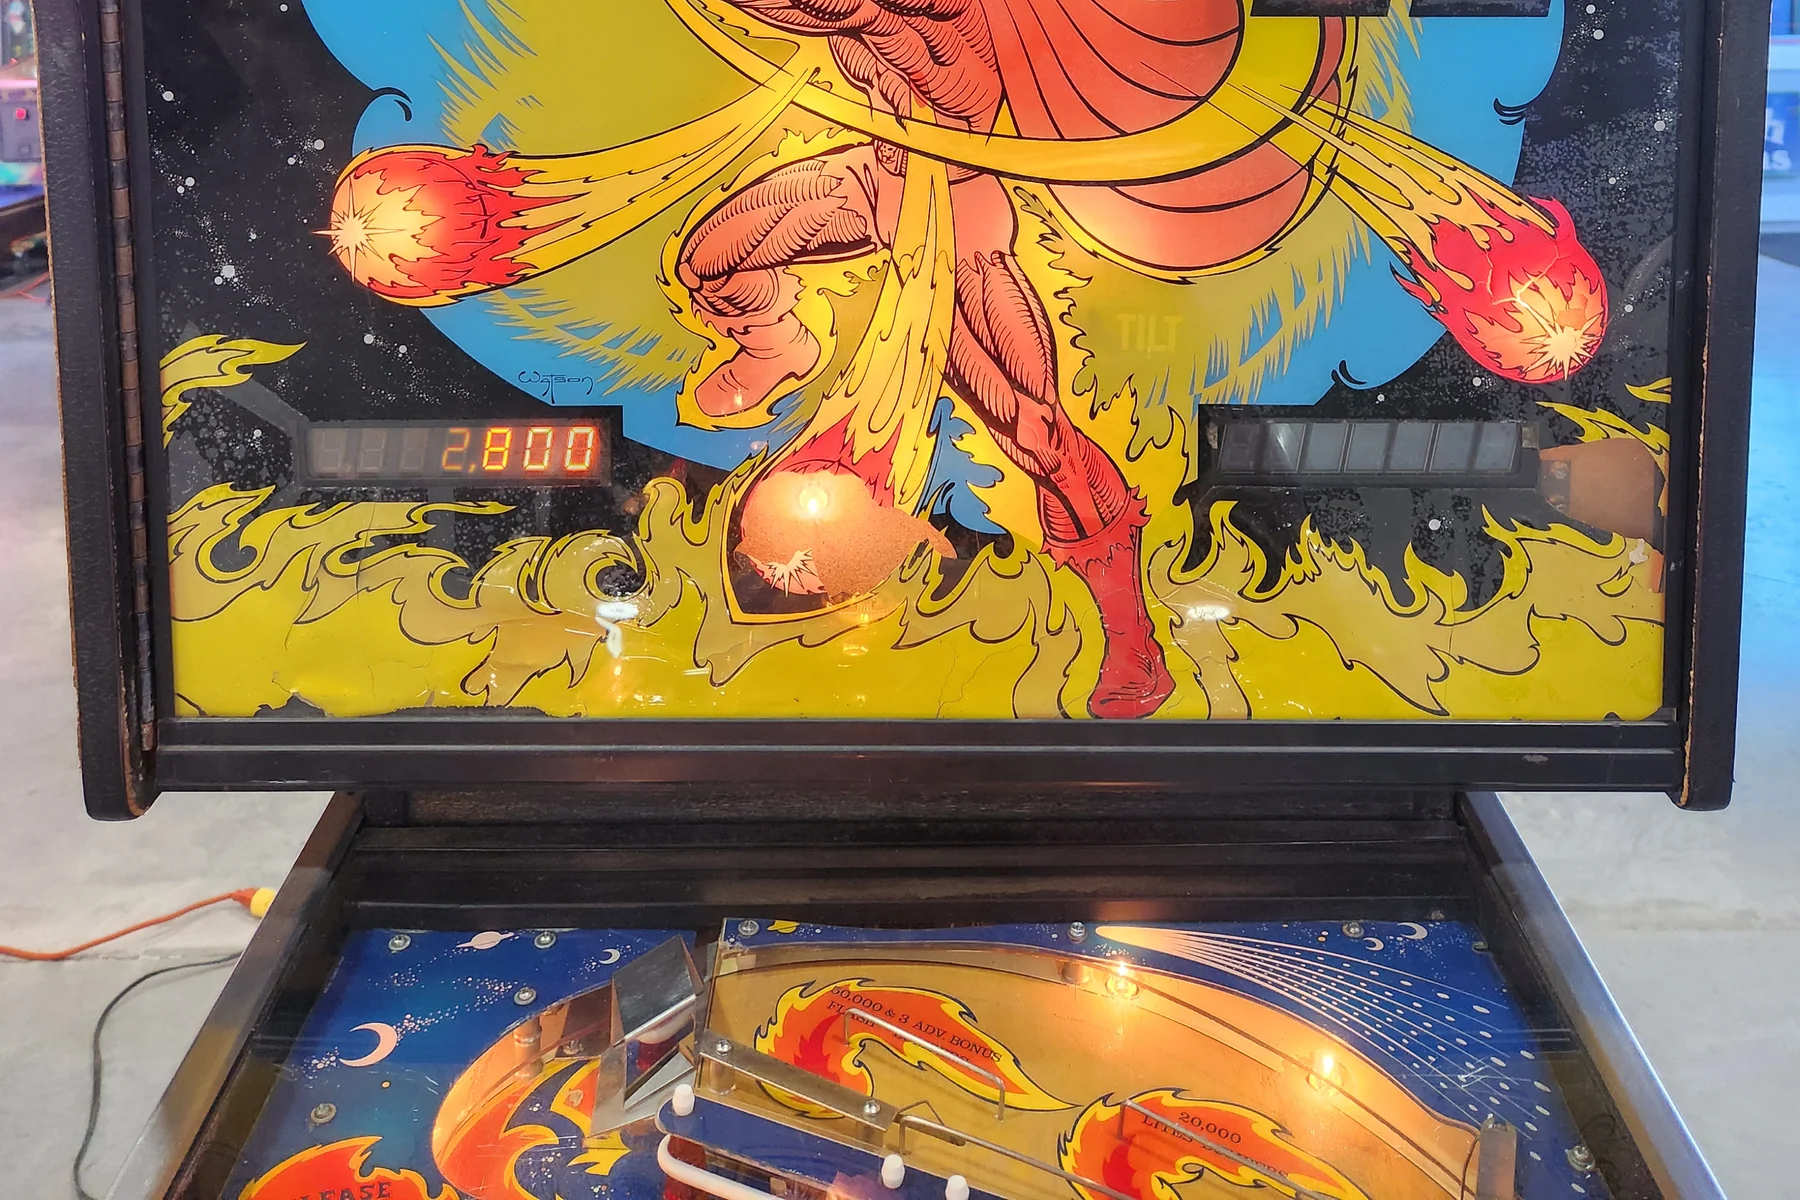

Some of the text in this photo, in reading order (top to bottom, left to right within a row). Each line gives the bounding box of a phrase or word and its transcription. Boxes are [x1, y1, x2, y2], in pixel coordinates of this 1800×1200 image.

[1115, 313, 1184, 352] TILT
[884, 1008, 896, 1019] &
[898, 1012, 911, 1025] 3
[911, 1020, 948, 1041] ADV.
[949, 1032, 1003, 1063] BONUS
[1177, 1111, 1242, 1145] 20,000
